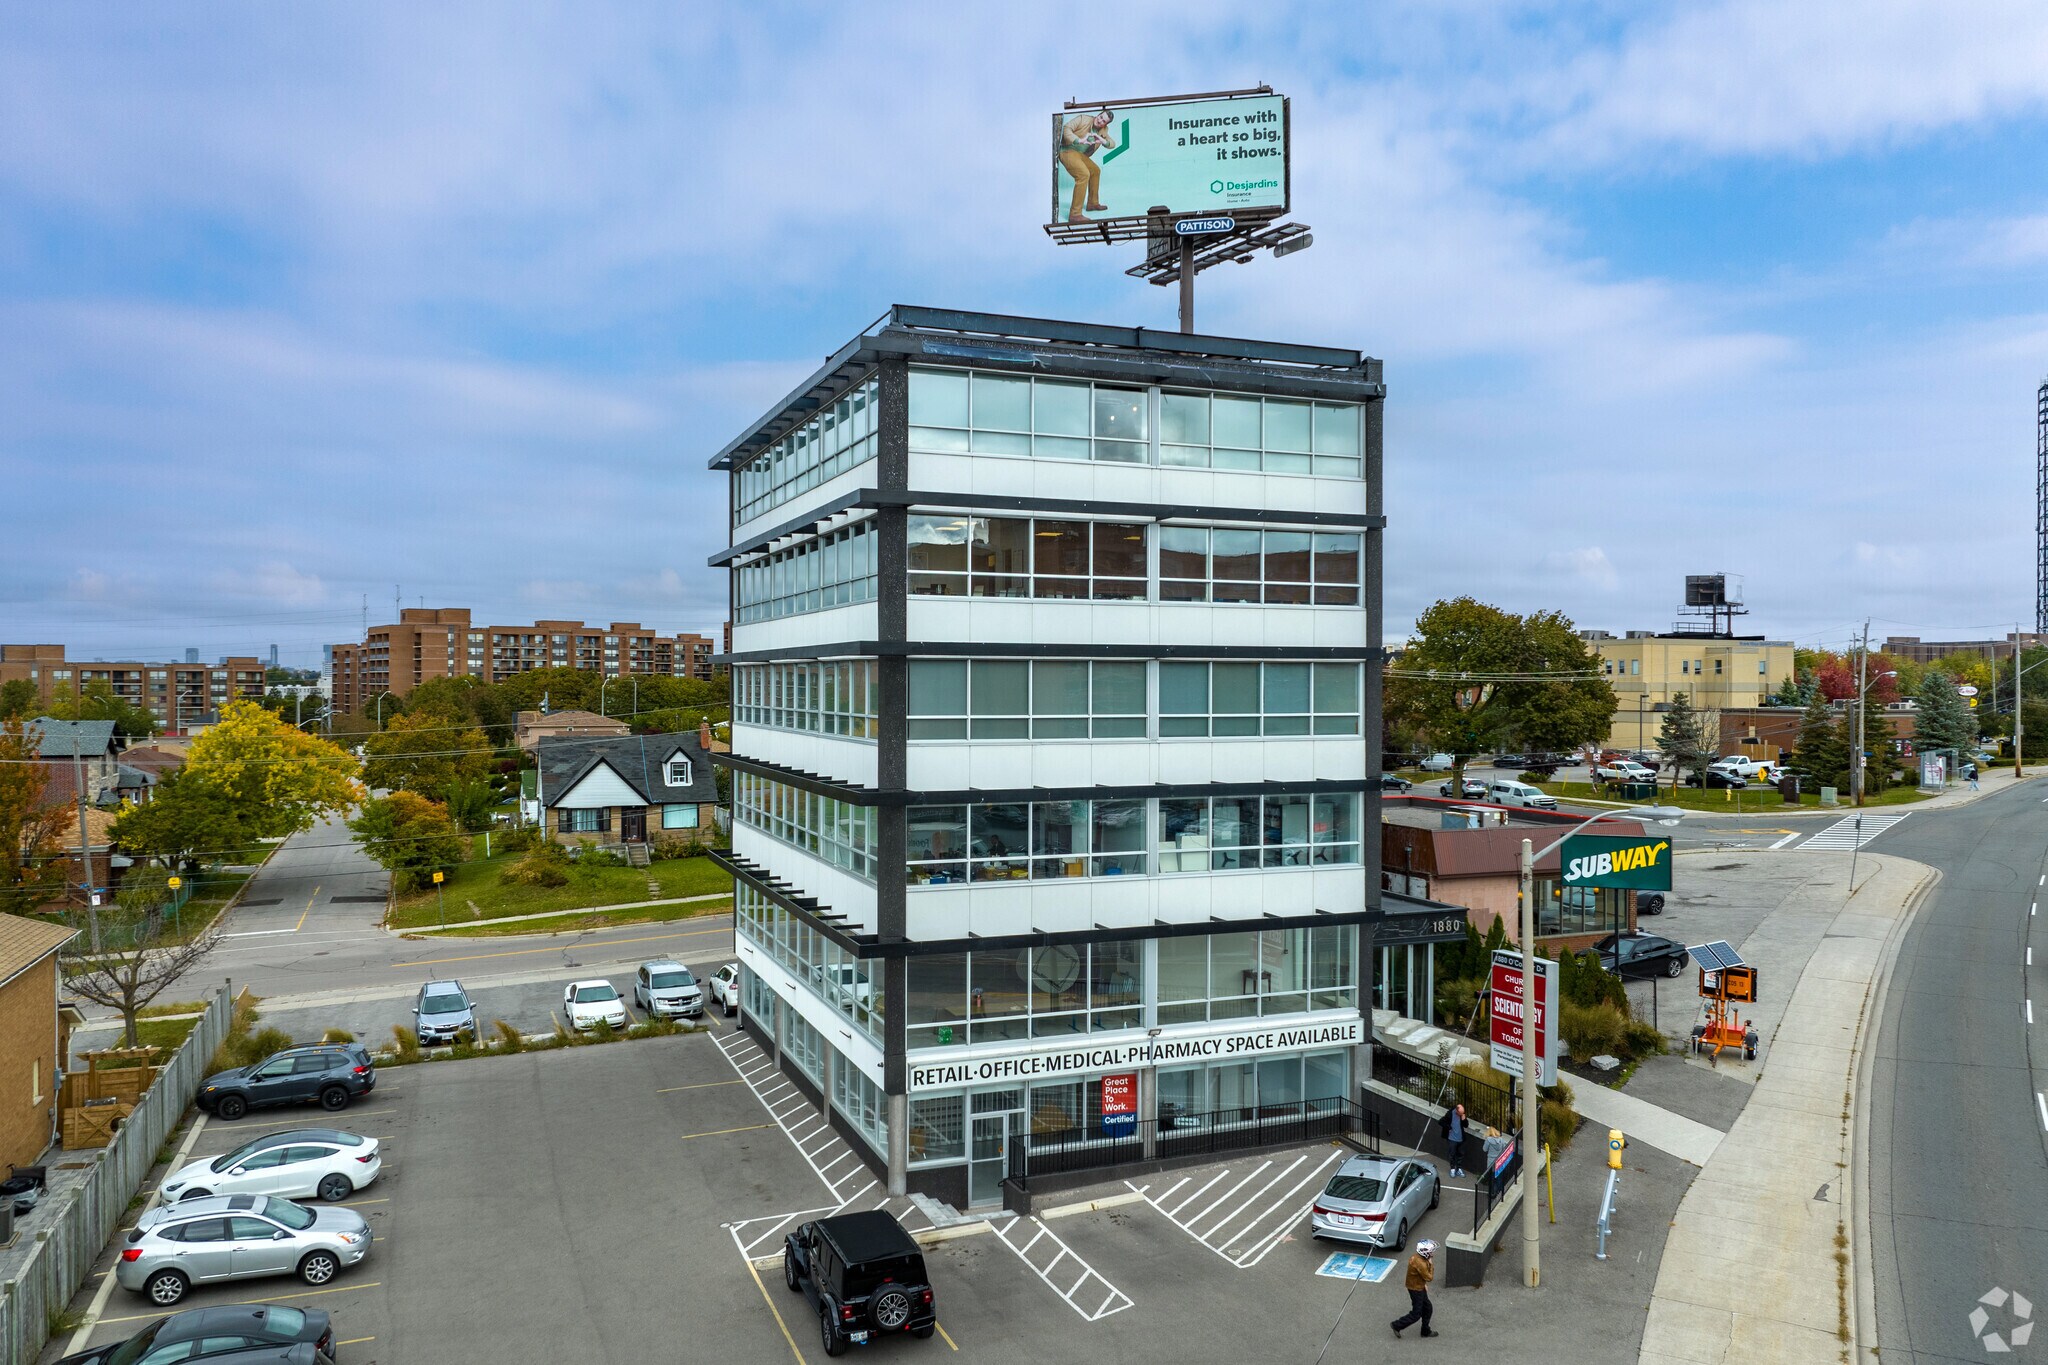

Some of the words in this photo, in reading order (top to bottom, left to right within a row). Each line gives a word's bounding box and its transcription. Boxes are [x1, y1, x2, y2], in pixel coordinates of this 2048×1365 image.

[1169, 116, 1240, 130] Insurance
[1244, 110, 1277, 124] with
[1178, 137, 1186, 146] a
[1190, 131, 1228, 145] heart
[1232, 132, 1249, 142] so
[1253, 128, 1281, 142] big,
[1217, 148, 1227, 160] it
[1231, 146, 1281, 159] shows.
[1227, 179, 1278, 191] Desjardins
[1180, 219, 1230, 231] PATTISON
[1563, 841, 1668, 882] SUBWAY
[1433, 920, 1460, 932] 1880
[1536, 964, 1544, 972] Dr
[1505, 975, 1523, 985] CHUR
[1514, 986, 1523, 994] OF
[1512, 1027, 1522, 1035] OF
[1226, 1033, 1274, 1052] SPACE
[1277, 1025, 1357, 1048] AVAILABLE
[1502, 1033, 1523, 1046] TORON
[1104, 1078, 1128, 1086] Great
[1105, 1086, 1128, 1094] Place
[1104, 1114, 1134, 1124] Certified
